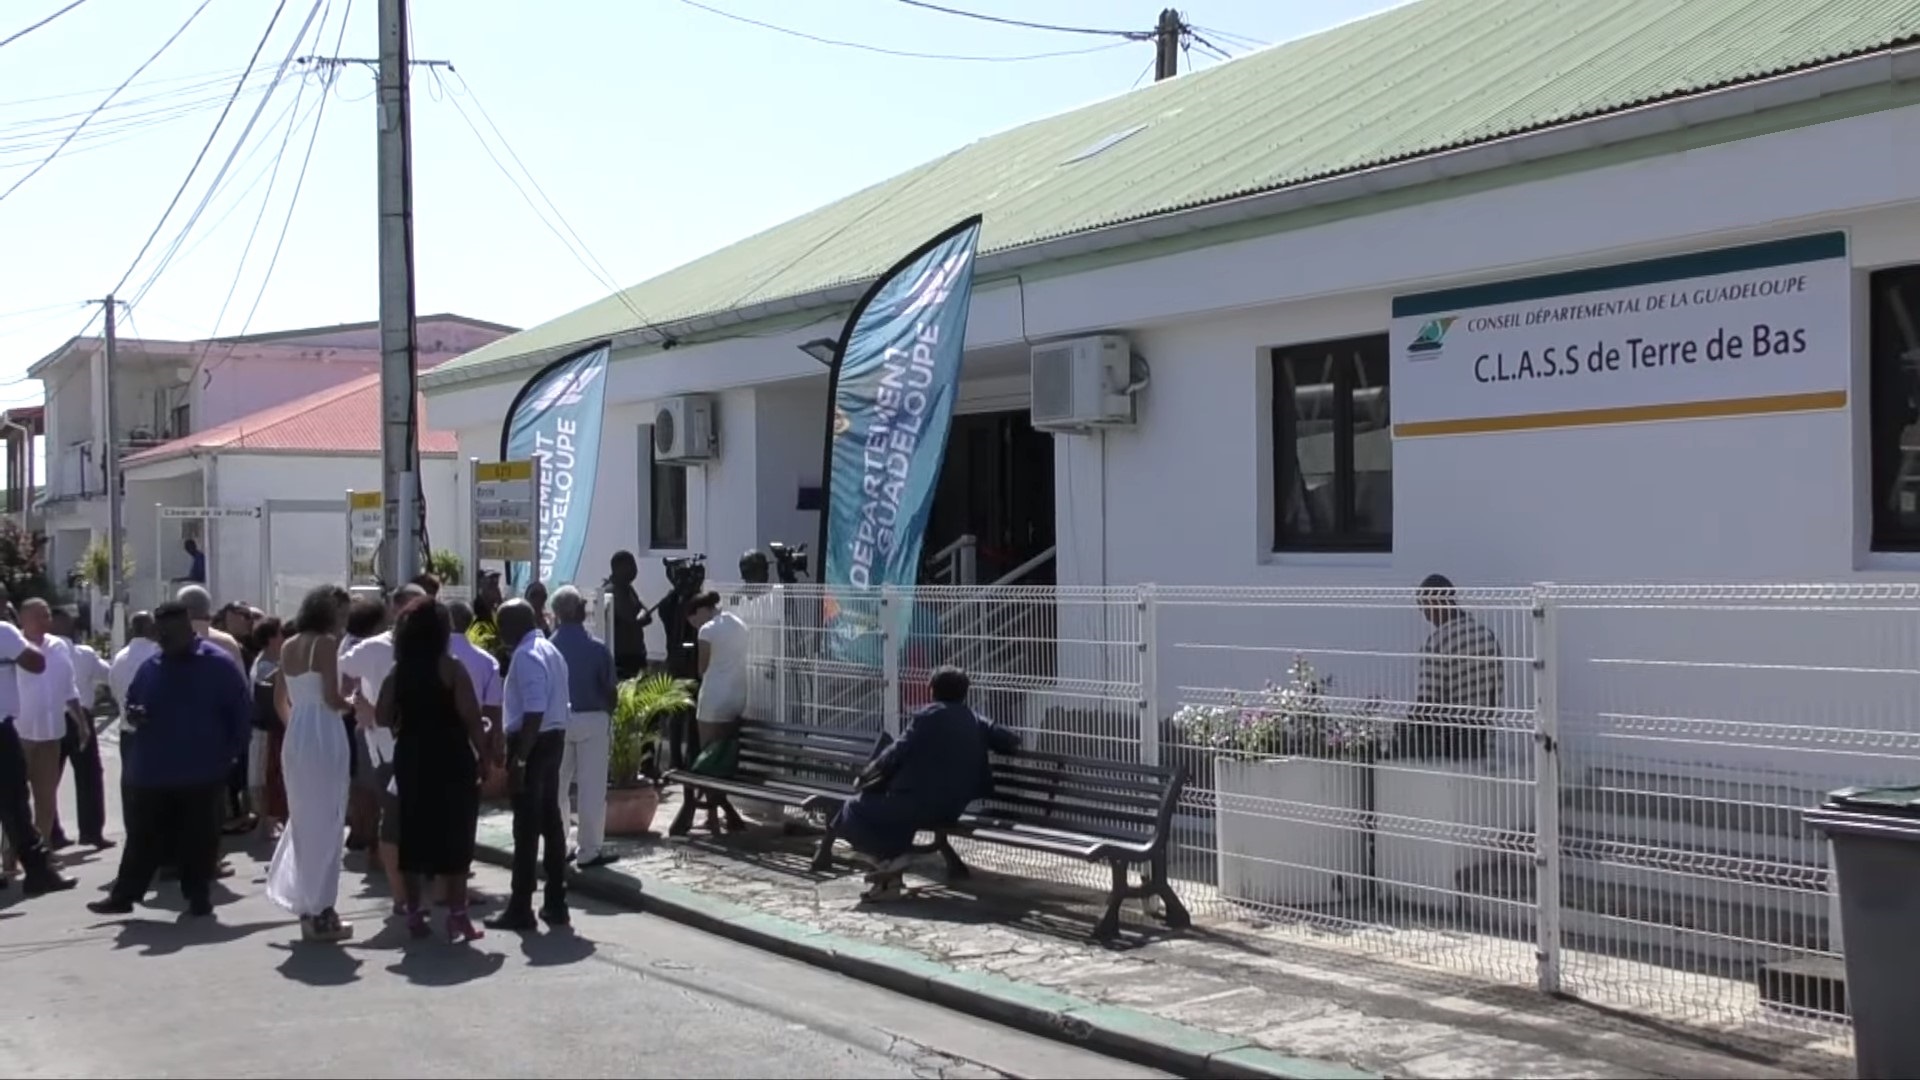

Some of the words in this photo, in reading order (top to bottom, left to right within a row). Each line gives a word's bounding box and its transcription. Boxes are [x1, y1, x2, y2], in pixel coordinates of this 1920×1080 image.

[1467, 313, 1521, 332] CONSEIL
[1525, 297, 1641, 326] DÉPARTEMENTAL
[1646, 292, 1667, 311] DE
[1670, 290, 1688, 308] LA
[1693, 275, 1807, 305] GUADELOUPE
[1474, 344, 1580, 384] C.L.A.S.S
[1587, 342, 1621, 373] de
[1626, 338, 1698, 370] Terre
[1706, 328, 1743, 362] de
[1753, 324, 1807, 358] Bas
[877, 322, 939, 556] GUADELOUPE
[540, 417, 577, 582] GUADELOUPE
